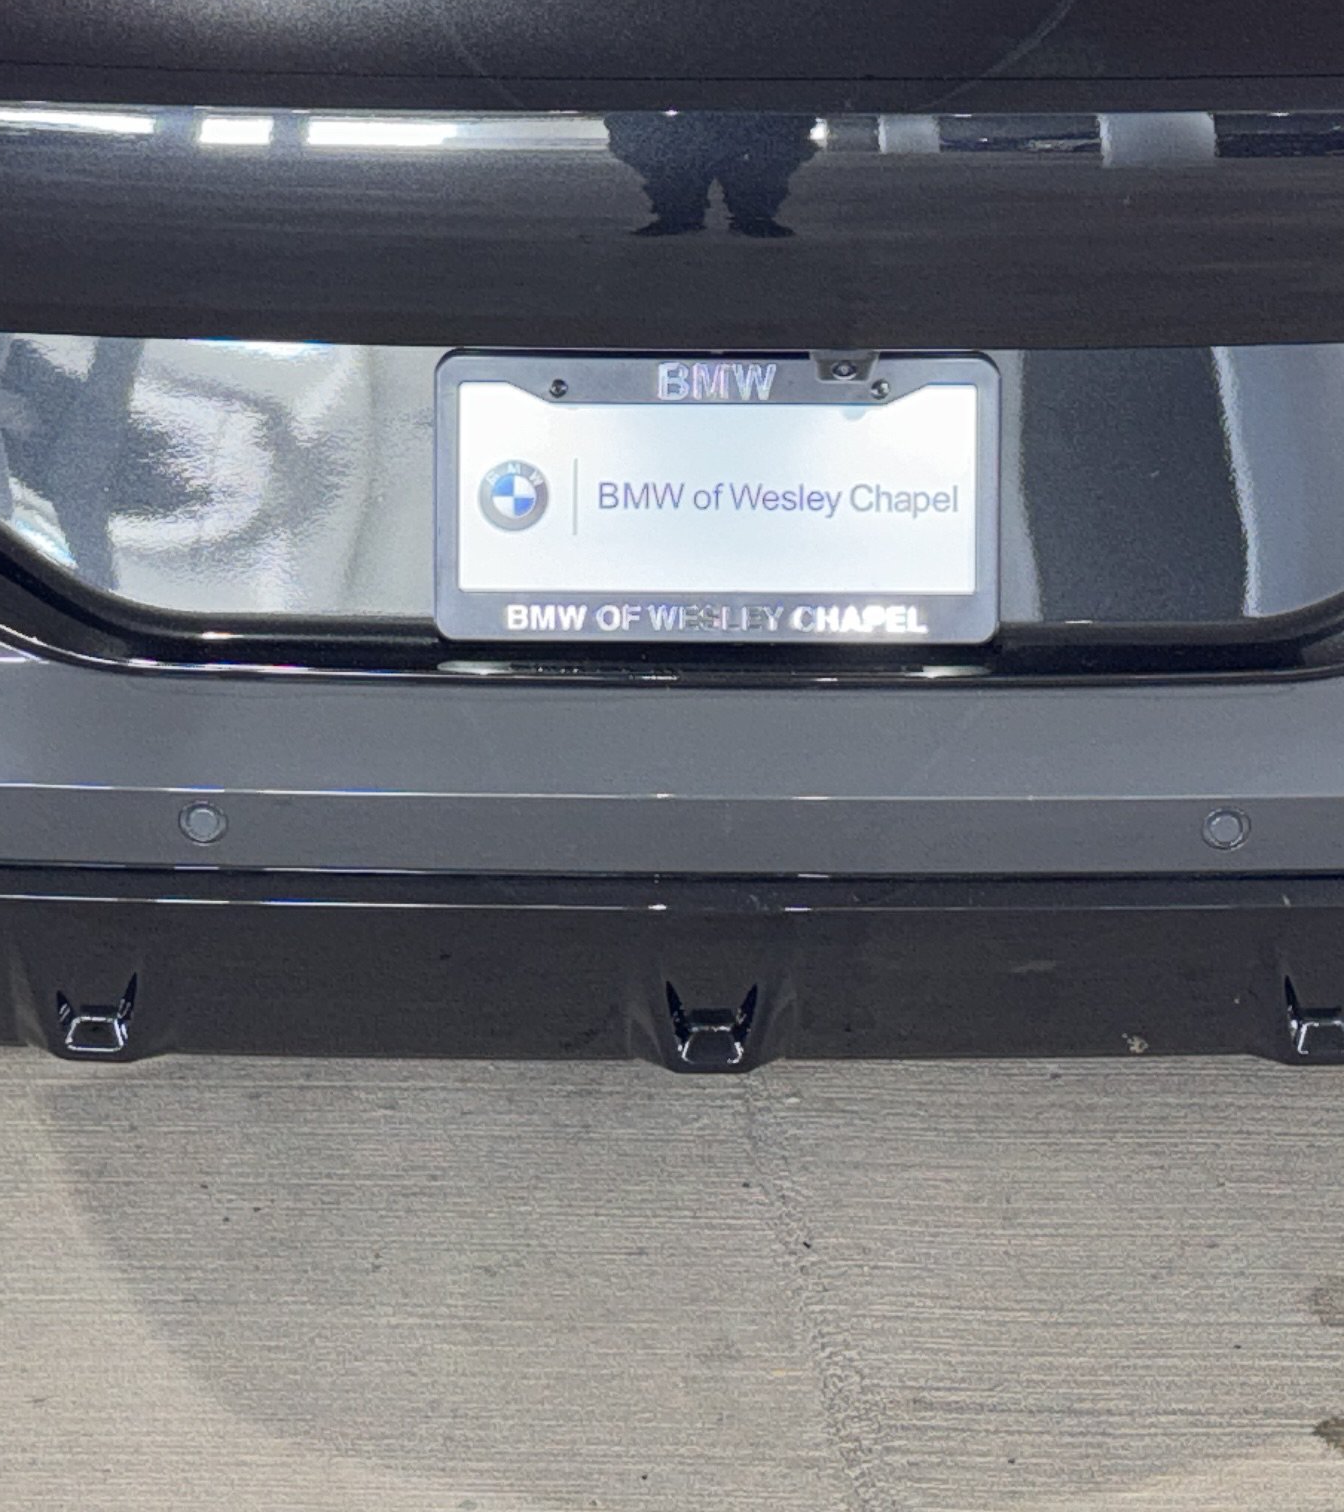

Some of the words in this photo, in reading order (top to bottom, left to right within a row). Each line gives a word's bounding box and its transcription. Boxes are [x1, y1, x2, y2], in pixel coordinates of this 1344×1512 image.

[658, 362, 777, 401] BMW
[485, 462, 545, 487] BMW
[597, 481, 685, 510] BMW
[692, 481, 725, 511] of
[729, 482, 842, 519] Wesley
[849, 483, 959, 519] Chapel
[506, 604, 588, 632] BMW
[595, 604, 642, 632] OF
[646, 605, 785, 633] WESLEY
[790, 604, 929, 635] CHAPEL
